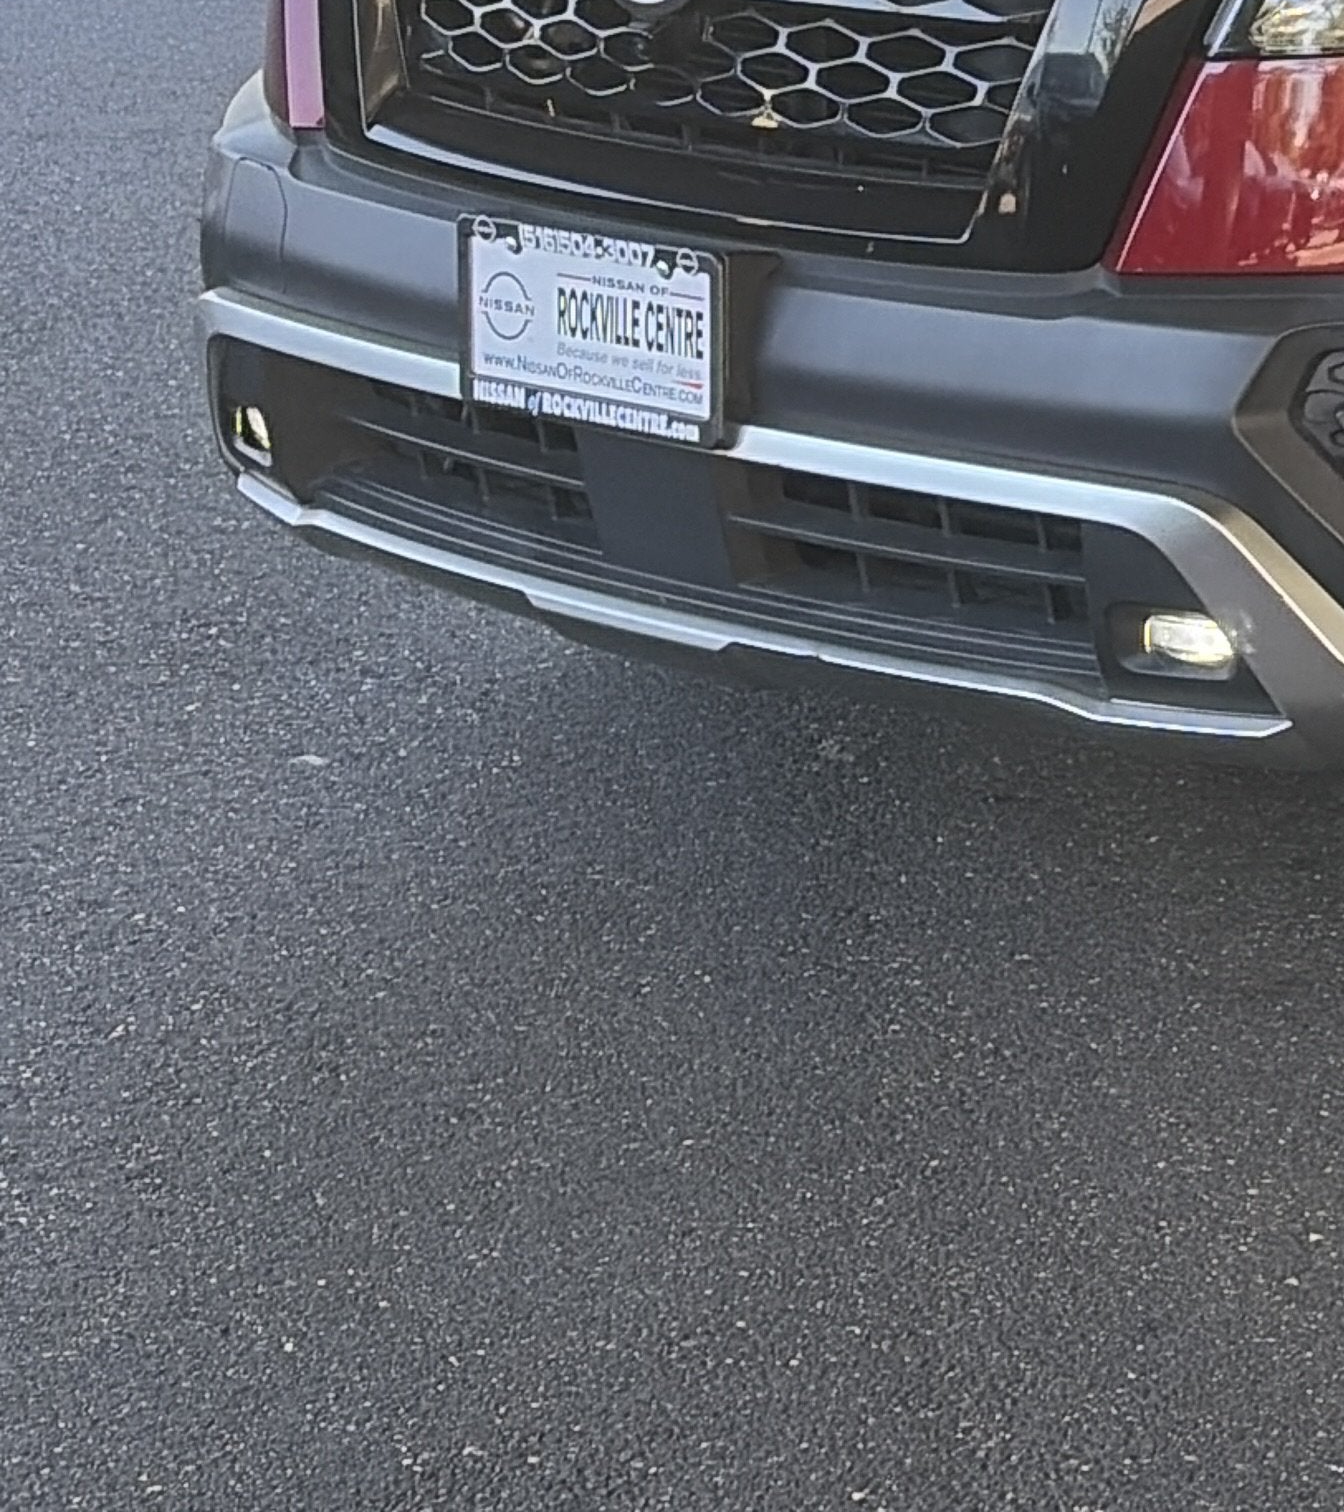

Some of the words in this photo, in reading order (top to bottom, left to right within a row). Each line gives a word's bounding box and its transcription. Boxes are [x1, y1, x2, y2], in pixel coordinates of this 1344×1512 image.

[592, 275, 645, 293] NISSAN
[649, 284, 669, 296] OF
[479, 295, 535, 316] NISSAN
[557, 287, 640, 348] ROCKVILLE
[644, 301, 704, 360] CENTRE
[557, 341, 608, 364] Because
[611, 354, 629, 367] we
[632, 355, 654, 372] sell
[656, 359, 674, 376] for
[676, 362, 701, 380] less
[473, 379, 526, 409] NISSAN
[527, 391, 541, 417] of
